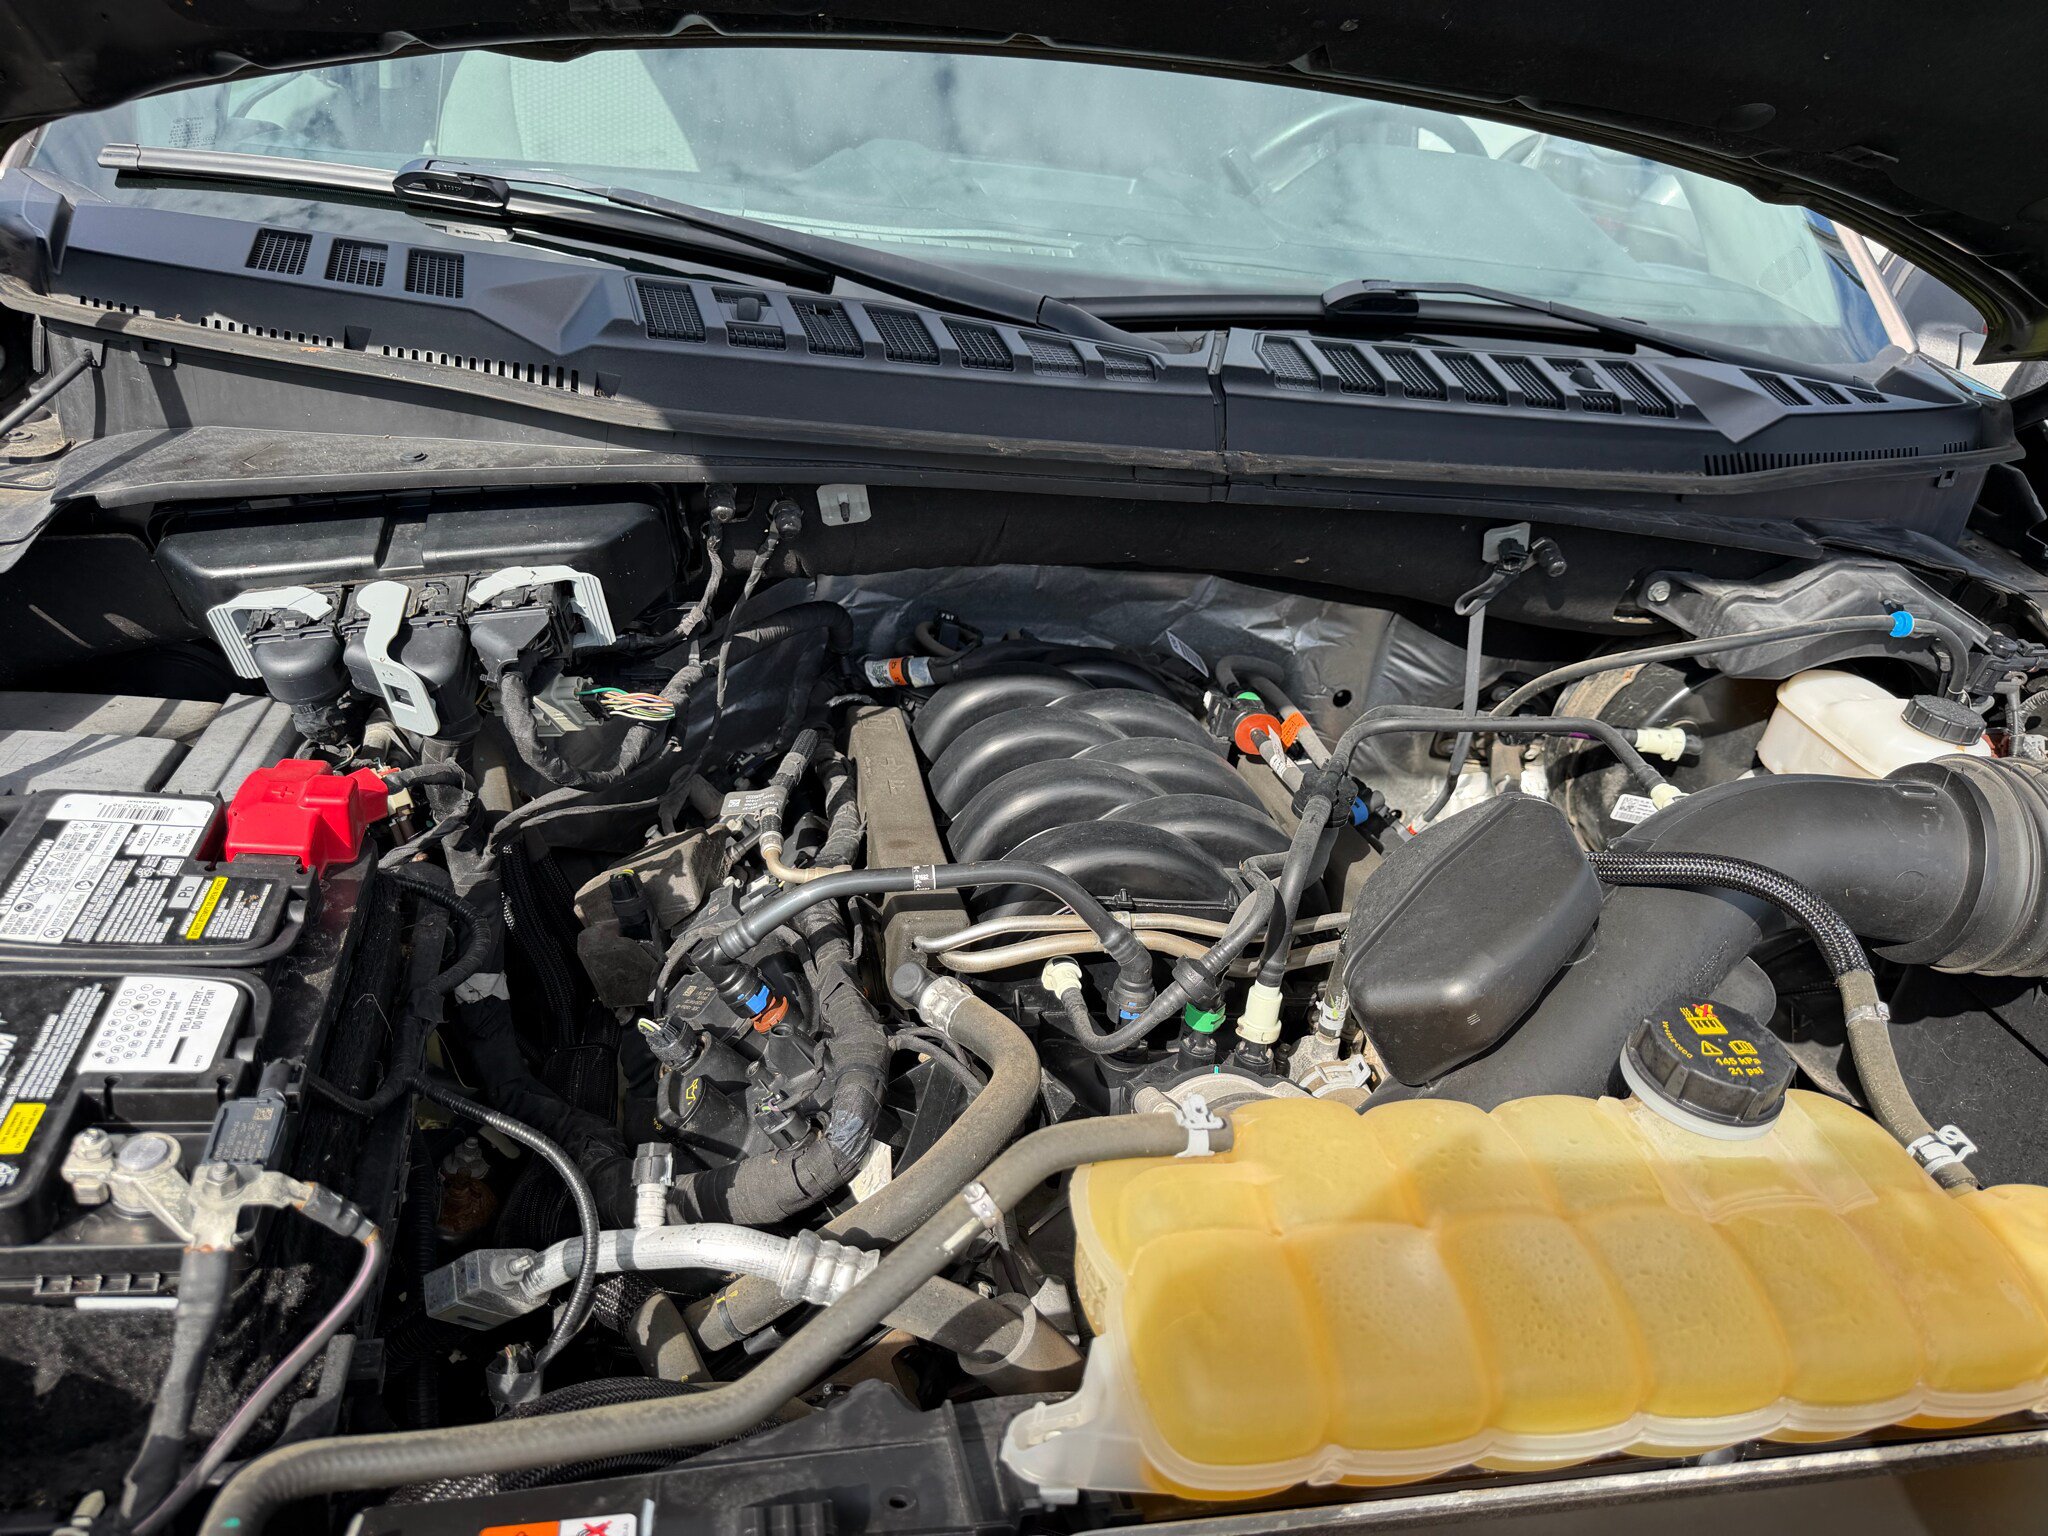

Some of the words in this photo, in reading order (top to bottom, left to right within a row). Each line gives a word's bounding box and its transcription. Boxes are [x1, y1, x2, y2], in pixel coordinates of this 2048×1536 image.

[176, 885, 195, 898] Pb
[184, 990, 204, 1015] BATTERY
[194, 1007, 208, 1019] NOT
[177, 1016, 194, 1032] VRLA
[190, 1020, 203, 1029] DO
[1716, 1057, 1737, 1067] 145
[1739, 1057, 1762, 1067] kPa
[1728, 1066, 1744, 1076] 21
[1746, 1066, 1764, 1076] psi
